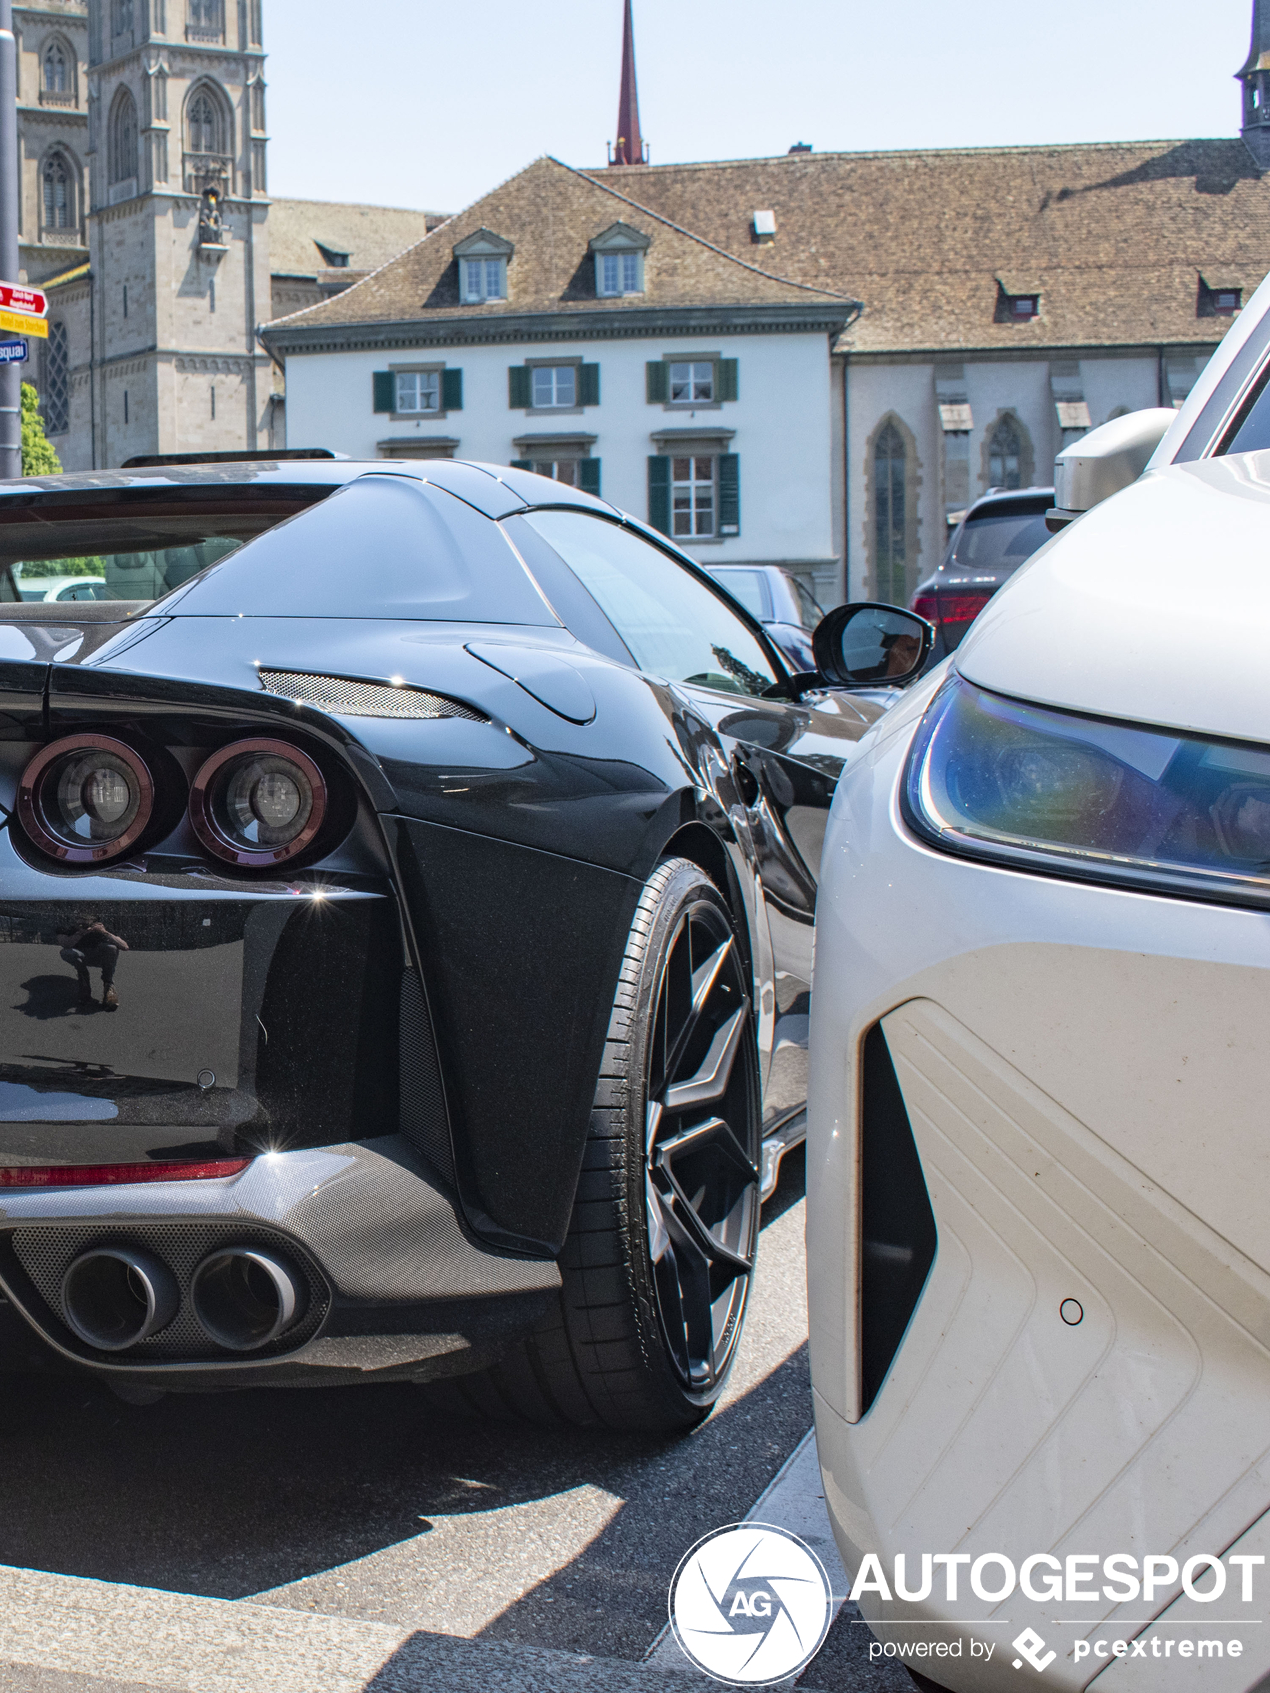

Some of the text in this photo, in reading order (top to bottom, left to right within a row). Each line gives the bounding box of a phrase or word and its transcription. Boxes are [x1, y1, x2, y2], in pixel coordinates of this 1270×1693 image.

[1, 315, 46, 333] Hotel zum Storchen
